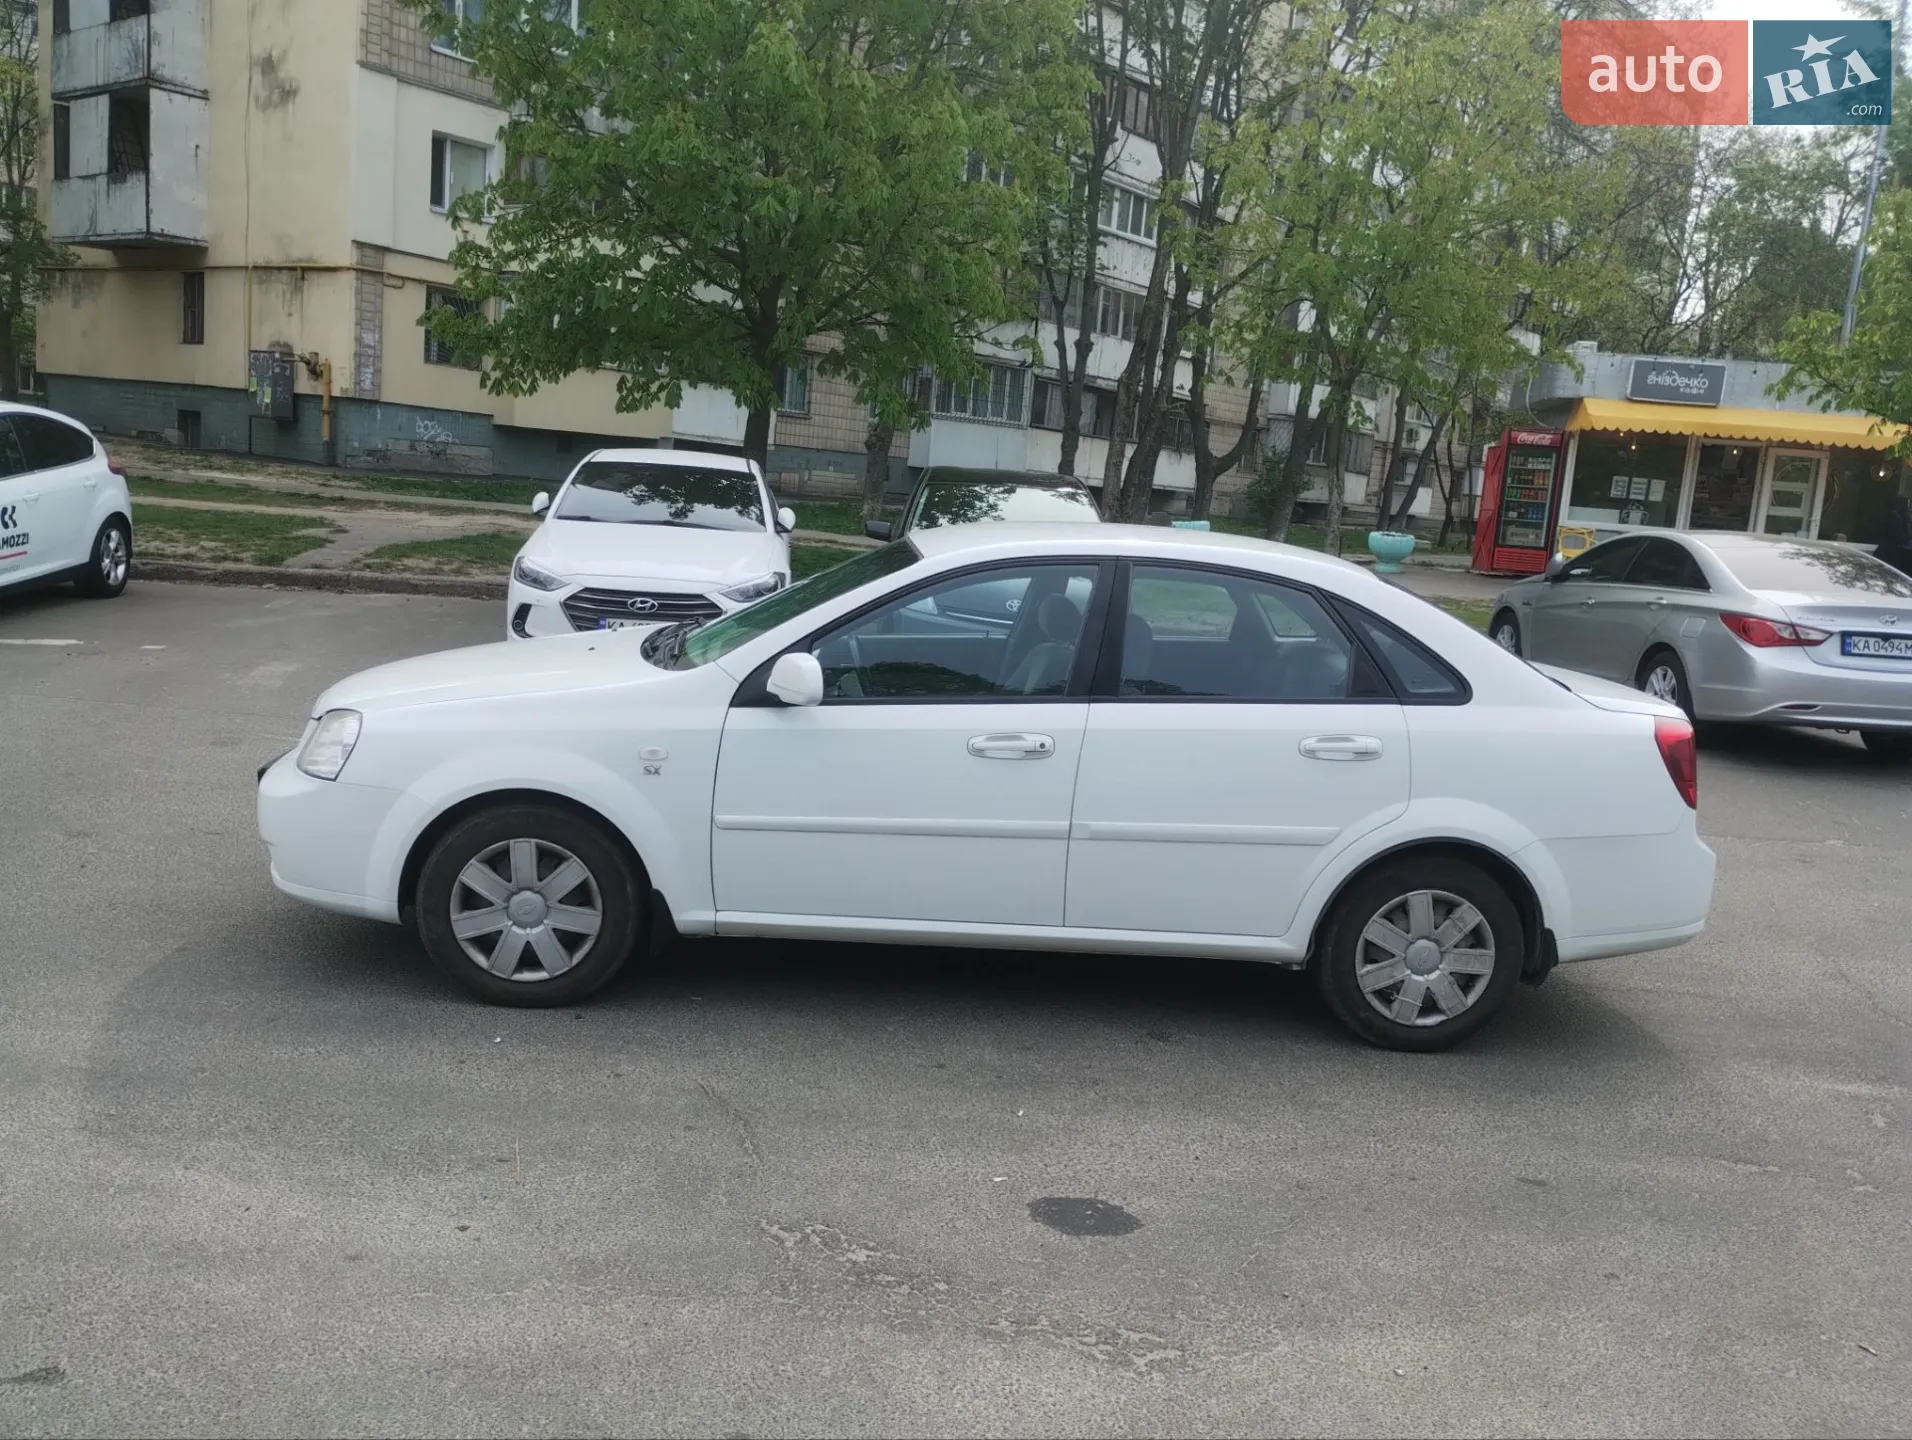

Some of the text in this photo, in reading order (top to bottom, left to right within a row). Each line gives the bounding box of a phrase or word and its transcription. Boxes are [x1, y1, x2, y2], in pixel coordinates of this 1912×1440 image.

[0, 532, 29, 550] MOZZI
[1852, 639, 1871, 652] KA
[1873, 640, 1902, 655] 0494
[643, 764, 662, 776] SX
